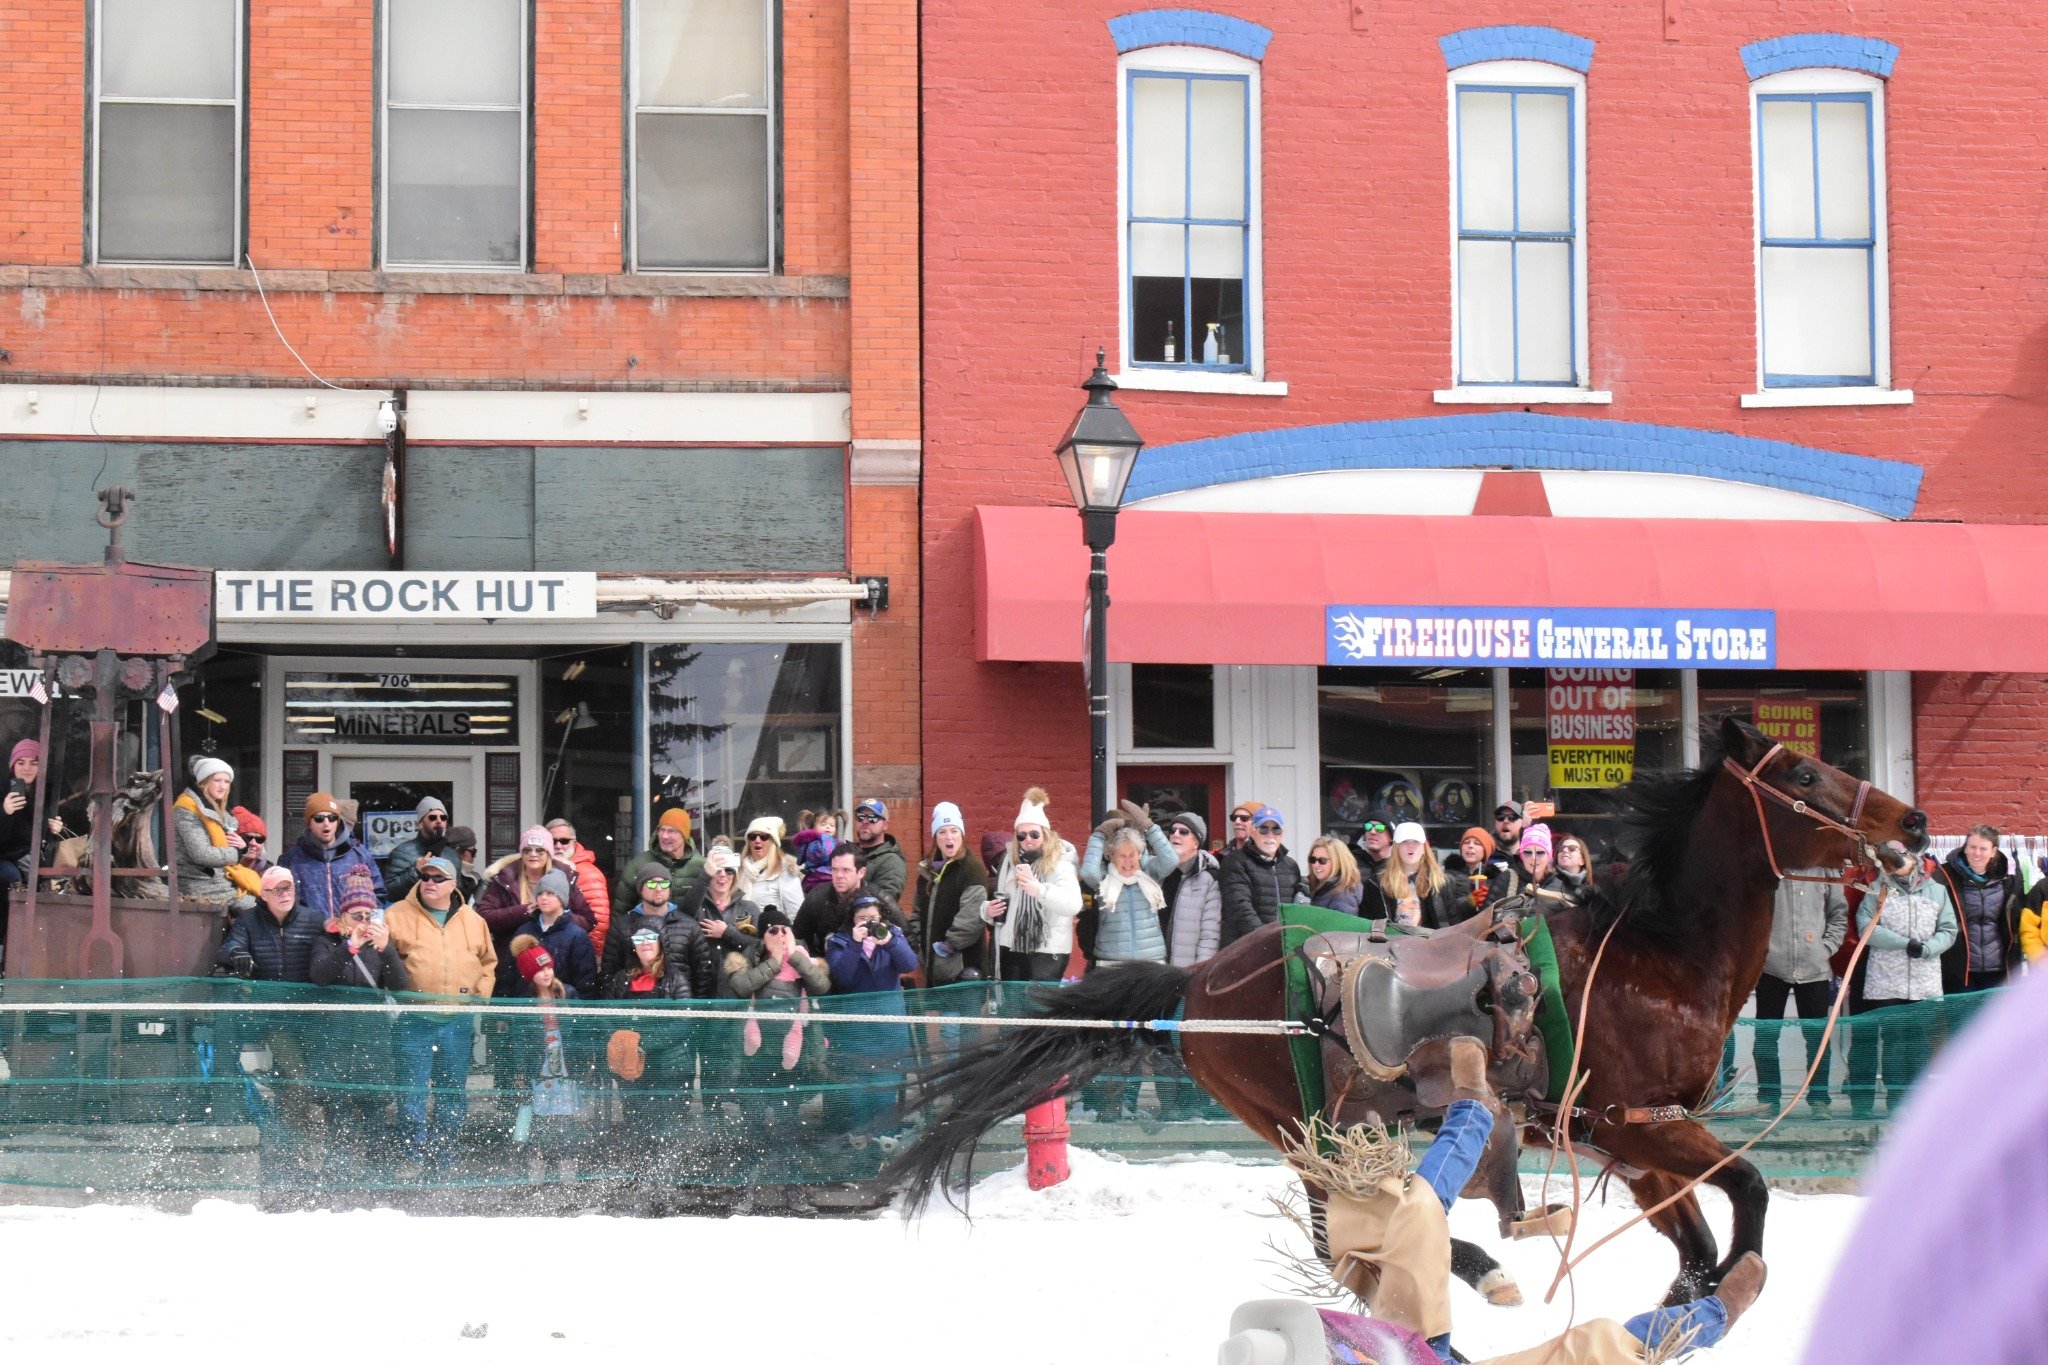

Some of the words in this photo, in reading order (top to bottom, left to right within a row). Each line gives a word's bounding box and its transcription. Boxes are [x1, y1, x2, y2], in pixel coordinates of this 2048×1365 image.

[226, 580, 313, 611] THE
[331, 580, 460, 612] ROCK
[476, 580, 564, 612] HUT
[1363, 617, 1530, 658] FIREHOUSE
[381, 674, 410, 687] 706
[1550, 686, 1597, 710] OUT
[1603, 686, 1632, 710] OF
[1759, 704, 1814, 720] GOING
[335, 714, 471, 735] MINERALS
[1551, 714, 1633, 740] BUSINESS
[1757, 722, 1791, 737] OUT
[1795, 723, 1817, 738] OF
[1551, 750, 1633, 765] EVERYTHING
[1564, 768, 1600, 782] MUST
[1604, 768, 1624, 782] GO
[372, 817, 420, 838] Ope
